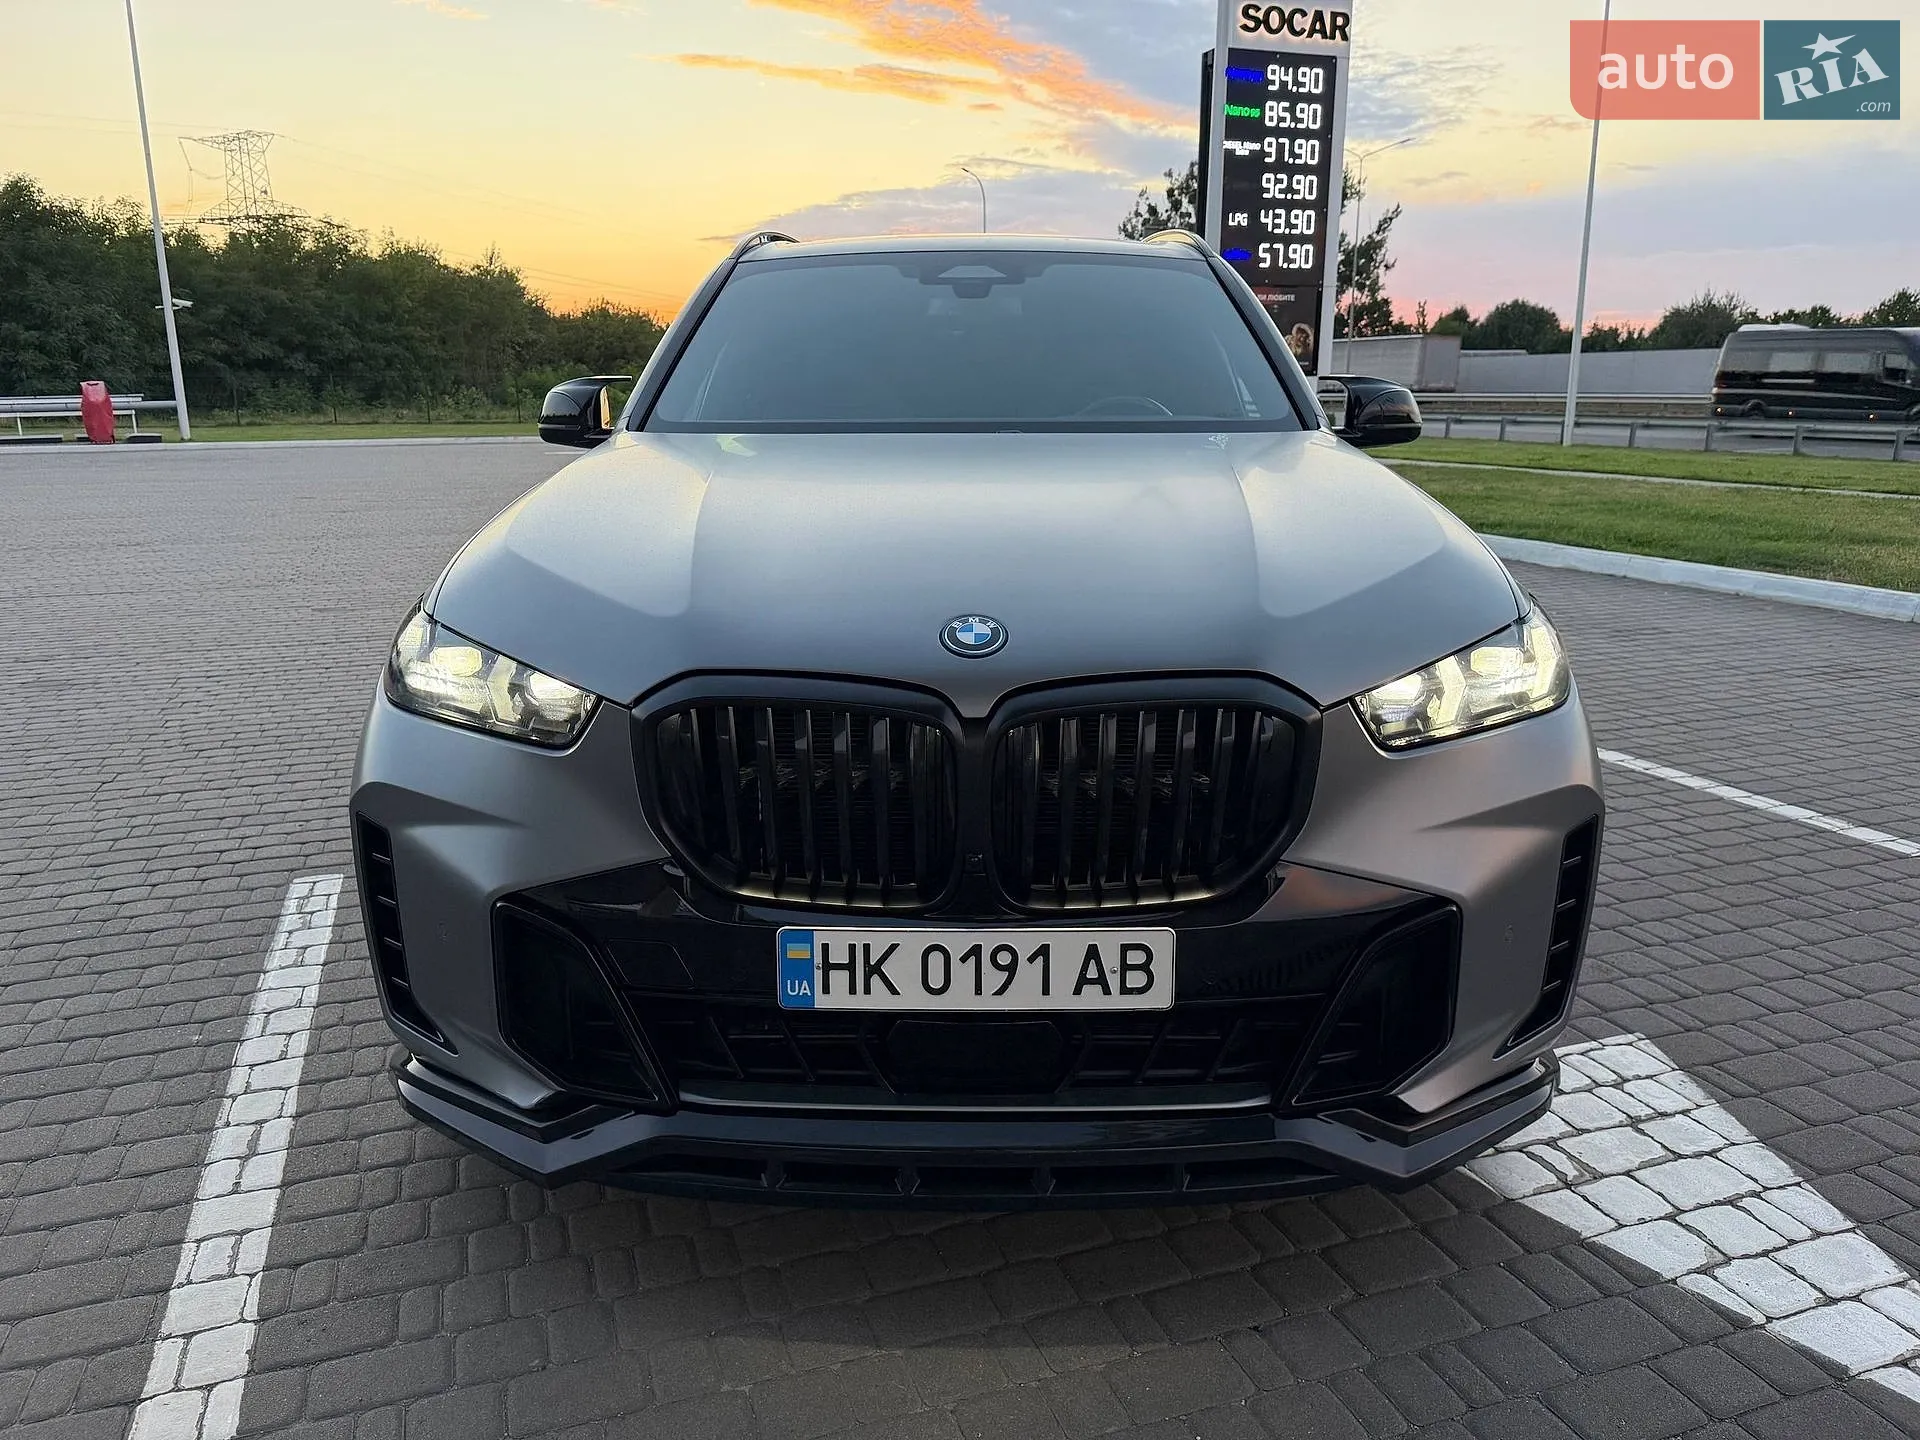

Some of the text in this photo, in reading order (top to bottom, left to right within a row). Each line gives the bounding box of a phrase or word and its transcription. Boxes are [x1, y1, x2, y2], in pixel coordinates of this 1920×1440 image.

[1239, 3, 1350, 42] SOCAR
[1267, 64, 1324, 94] 94.90
[1264, 100, 1322, 129] 85.90
[1263, 137, 1320, 165] 97.90
[1261, 172, 1318, 200] 92.90
[1228, 208, 1316, 235] LPG 43.90
[1258, 242, 1314, 269] 57.90
[820, 942, 1155, 996] HK 0191 AB
[786, 979, 812, 996] UA
